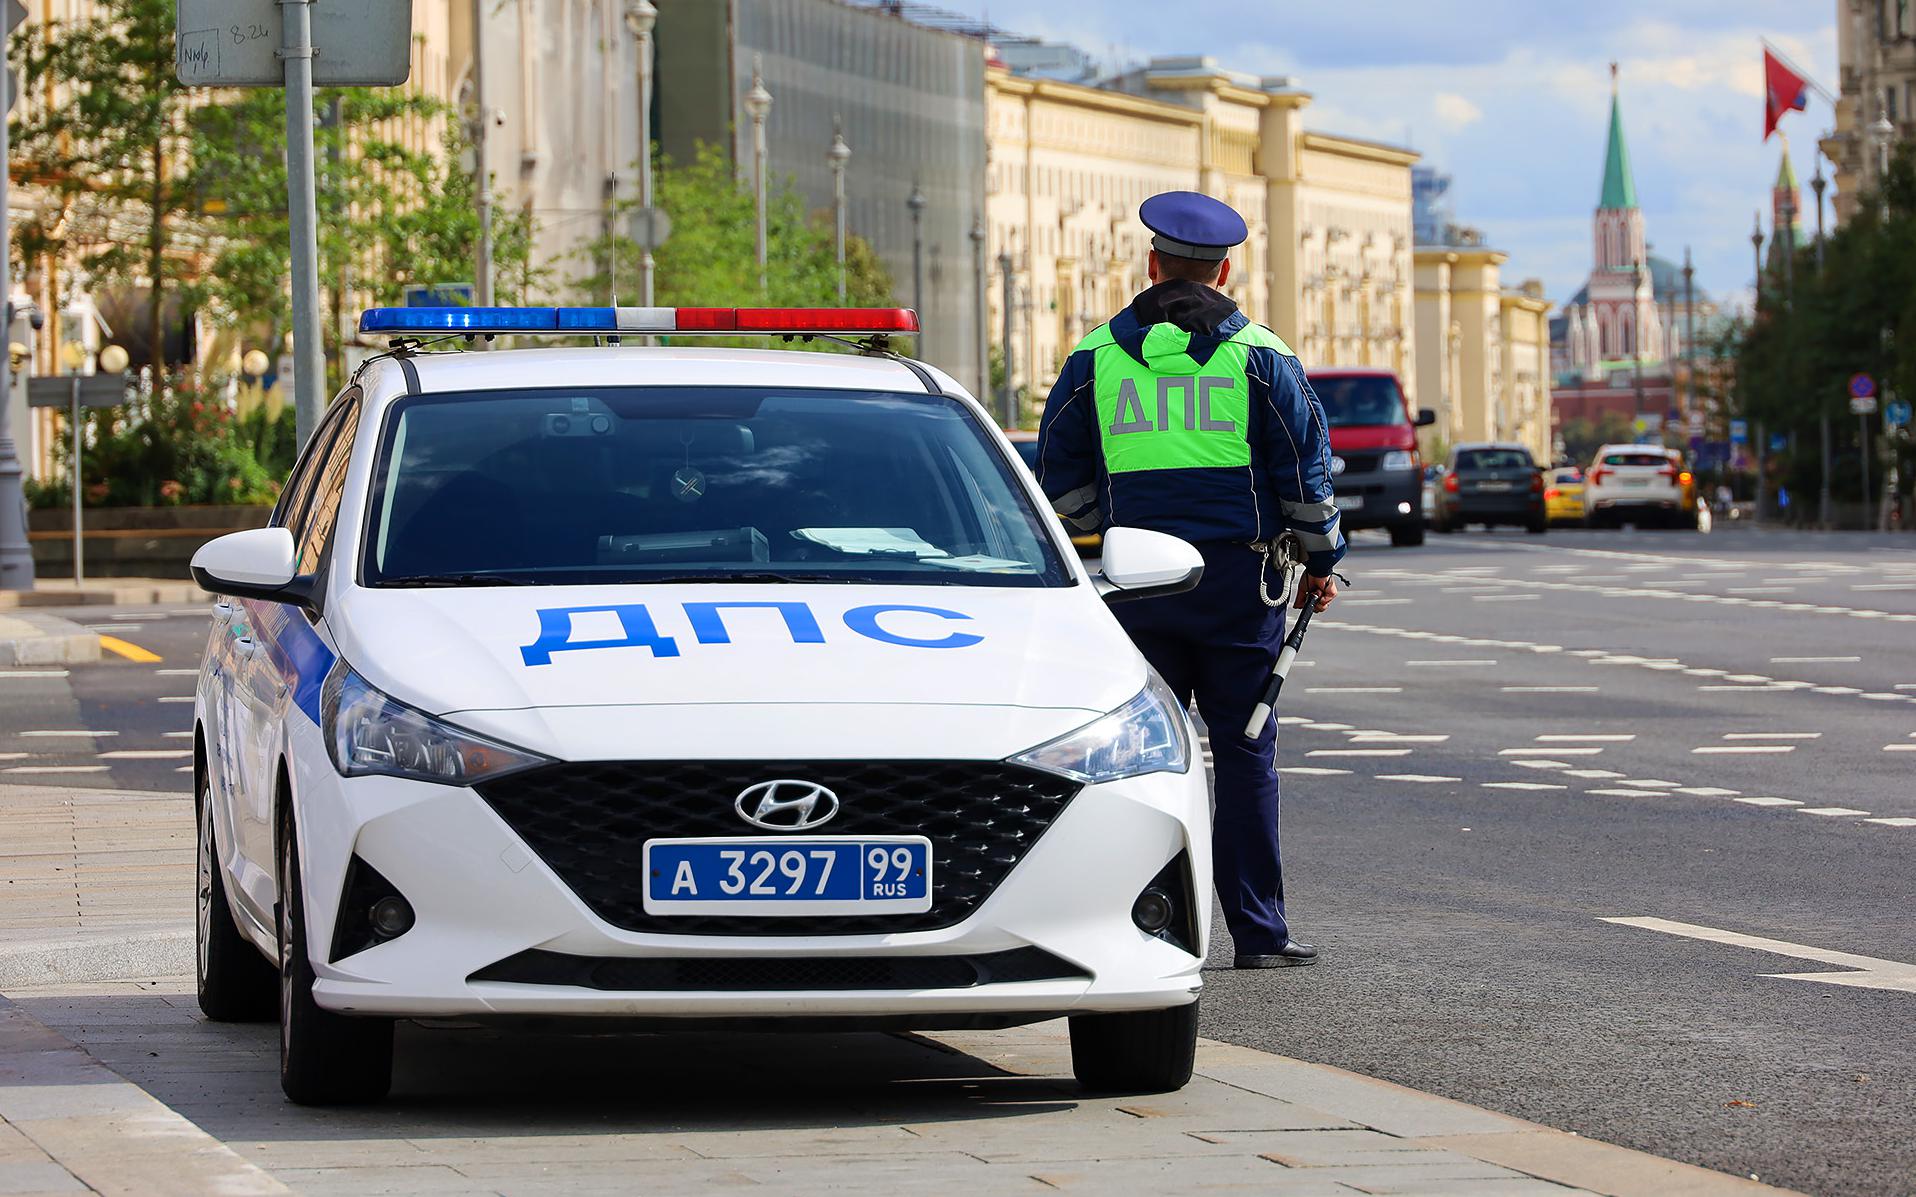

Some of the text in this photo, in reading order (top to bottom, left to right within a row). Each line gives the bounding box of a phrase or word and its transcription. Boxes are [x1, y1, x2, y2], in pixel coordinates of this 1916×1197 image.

[1109, 376, 1235, 435] ДПС
[520, 602, 985, 667] ДПС
[671, 848, 913, 895] А 3297 99
[873, 883, 907, 896] RUS
